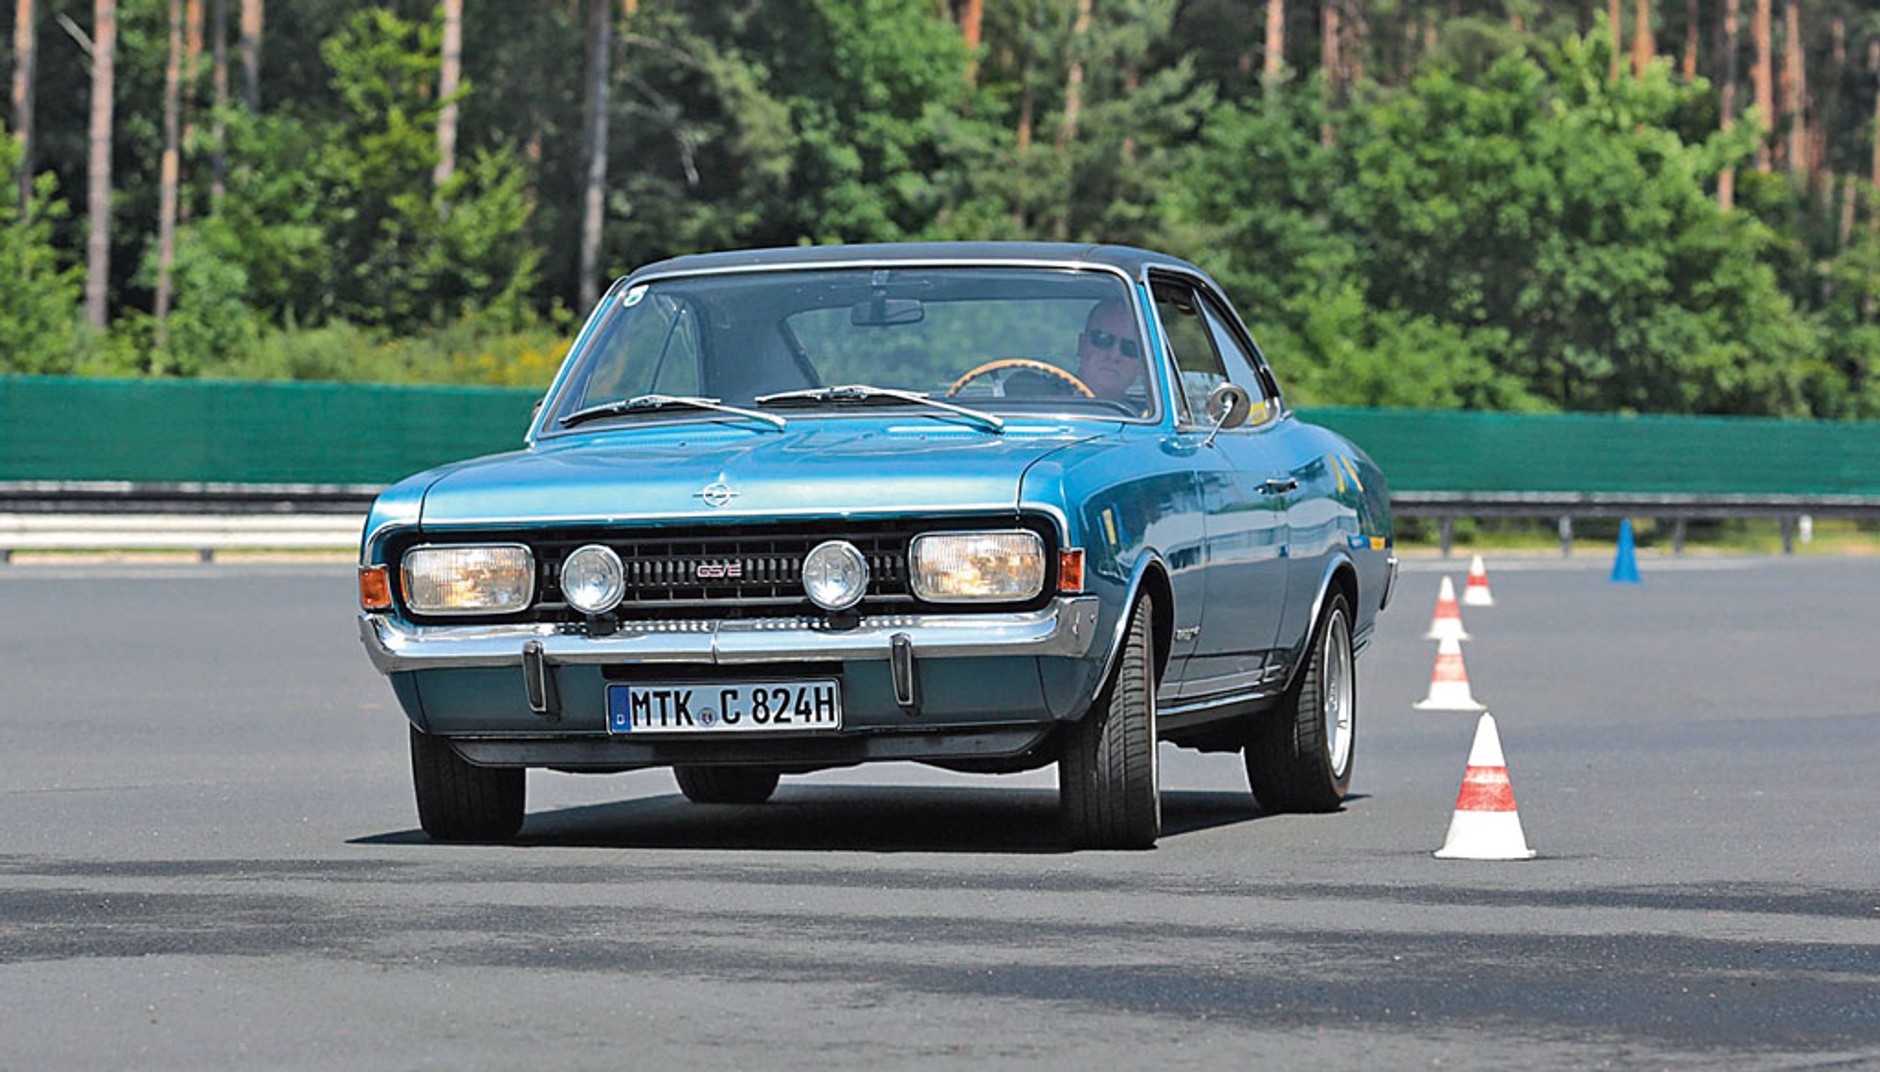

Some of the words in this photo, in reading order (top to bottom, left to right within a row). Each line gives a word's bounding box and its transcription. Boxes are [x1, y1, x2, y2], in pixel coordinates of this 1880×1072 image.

[631, 691, 694, 726] MTK
[720, 691, 741, 724] C
[751, 687, 834, 724] 824H
